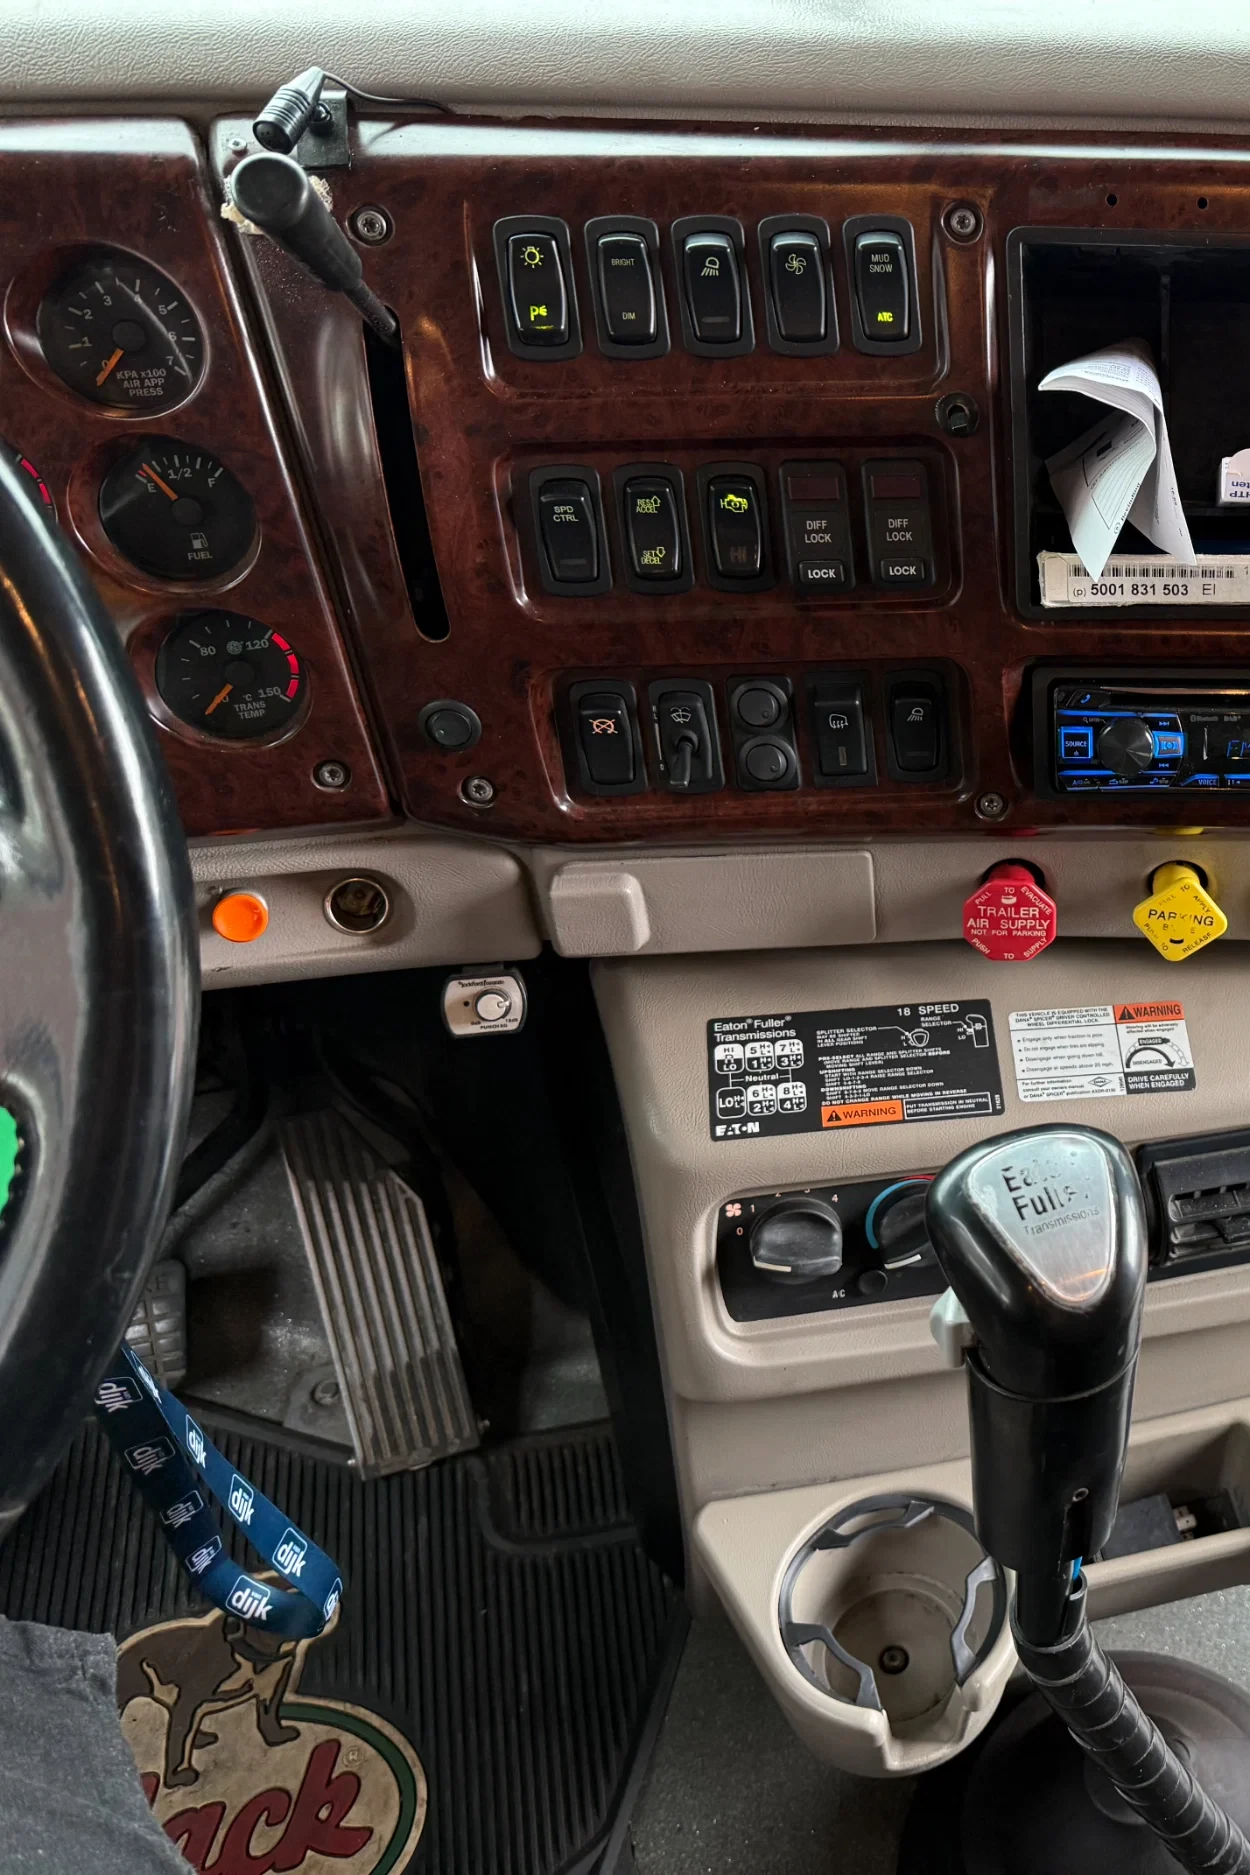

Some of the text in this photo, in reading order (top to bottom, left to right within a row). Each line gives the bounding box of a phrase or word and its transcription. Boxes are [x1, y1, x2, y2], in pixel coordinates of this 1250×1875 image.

[611, 258, 635, 266] BRIGHT
[871, 254, 890, 263] MUD
[869, 264, 893, 273] SNOW
[104, 296, 112, 306] 3
[83, 309, 93, 320] 2
[158, 305, 167, 315] 5
[622, 312, 636, 320] DIM
[877, 312, 894, 322] ATC
[168, 331, 177, 342] 6
[82, 337, 92, 347] 1
[166, 356, 175, 366] 7
[116, 370, 138, 380] KPA
[123, 378, 165, 388] AIR APP
[129, 388, 164, 397] PRESS
[167, 467, 192, 480] 1/2
[207, 477, 216, 488] F
[147, 483, 156, 493] E
[554, 505, 574, 513] SPD
[636, 505, 658, 513] ACCEL
[553, 514, 579, 522] CTRL
[888, 518, 909, 528] DIFF
[806, 520, 828, 530] DIFF
[804, 533, 832, 543] LOCK
[886, 532, 913, 542] LOCK
[187, 551, 213, 560] FUEL
[642, 550, 656, 558] SET
[640, 556, 662, 565] DECEL
[807, 569, 836, 579] LOCK
[889, 566, 917, 576] LOCK
[1073, 587, 1086, 597] (p)
[1090, 583, 1124, 596] 5001
[1131, 583, 1156, 596] 831
[1163, 584, 1189, 596] 503
[245, 638, 269, 651] 120
[200, 645, 216, 656] 80
[257, 686, 282, 698] 150
[234, 701, 266, 712] TRANS
[238, 709, 265, 720] TEMP
[1065, 740, 1087, 748] SOURCE
[1180, 884, 1190, 892] TO
[974, 891, 992, 905] PULL
[1021, 886, 1053, 916] EVACUATE
[1193, 895, 1211, 913] APPLY
[977, 905, 1039, 918] TRAILER
[967, 918, 1051, 929] AIR SUPPLY
[972, 938, 991, 955] PUSH
[1023, 937, 1047, 957] SUPPLY
[897, 1003, 960, 1017] 18 SPEED
[1133, 1004, 1181, 1018] WARNING
[714, 1029, 796, 1042] Transmissions
[779, 1044, 786, 1052] 7
[781, 1057, 789, 1066] 3
[745, 1073, 779, 1082] Neutral
[1127, 1073, 1189, 1083] DRIVE CAREFULLY
[1128, 1082, 1150, 1090] WHEN
[1151, 1080, 1185, 1088] ENGAGED
[752, 1090, 760, 1098] 6
[783, 1087, 791, 1095] 8
[719, 1098, 734, 1108] LO
[783, 1101, 791, 1109] 4
[753, 1104, 762, 1113] 2
[842, 1106, 897, 1119] WARNING
[832, 1193, 839, 1203] 4
[231, 1488, 255, 1526] dijk
[277, 1541, 307, 1577] dijk
[232, 1588, 273, 1621] dijk
[141, 1739, 374, 1875] ack
